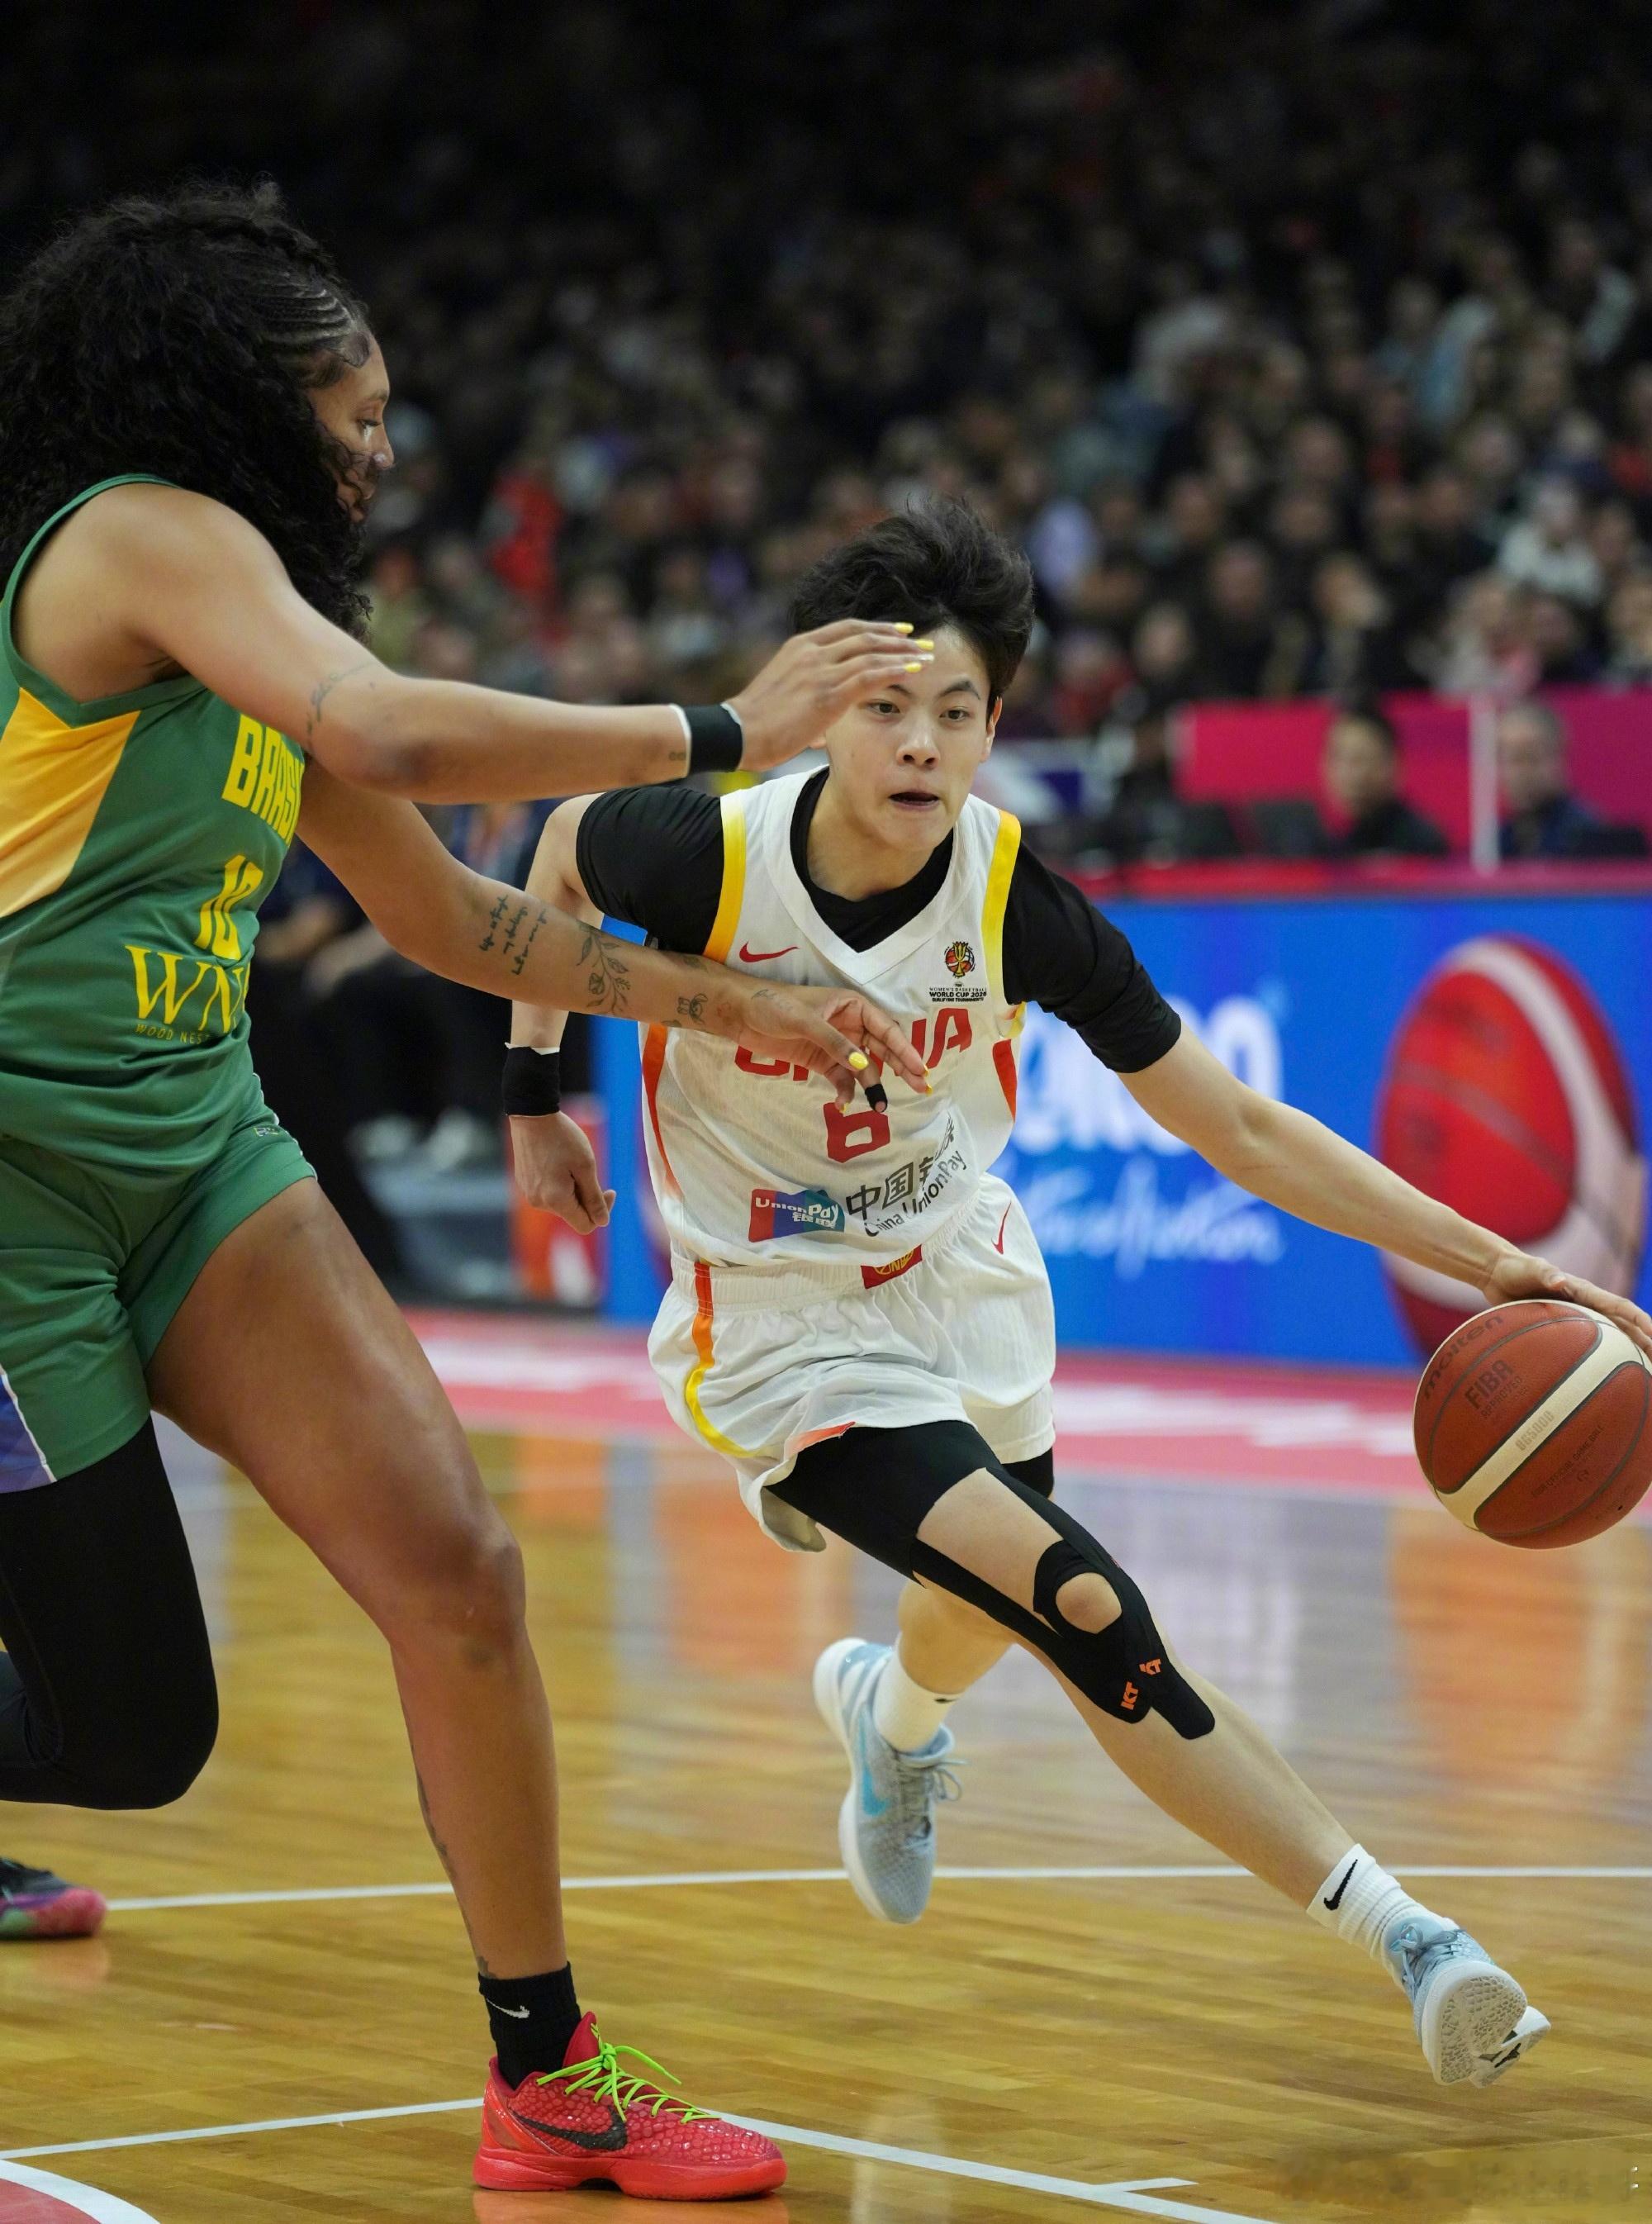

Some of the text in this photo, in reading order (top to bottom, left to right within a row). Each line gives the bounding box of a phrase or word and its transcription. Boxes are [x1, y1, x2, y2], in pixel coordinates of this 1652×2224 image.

[194, 854, 263, 960] 10
[125, 945, 251, 1033] WN
[135, 1024, 173, 1040] WOOD
[824, 1102, 890, 1163] 6
[1423, 1315, 1502, 1400] molten
[1464, 1360, 1513, 1409] FIBA
